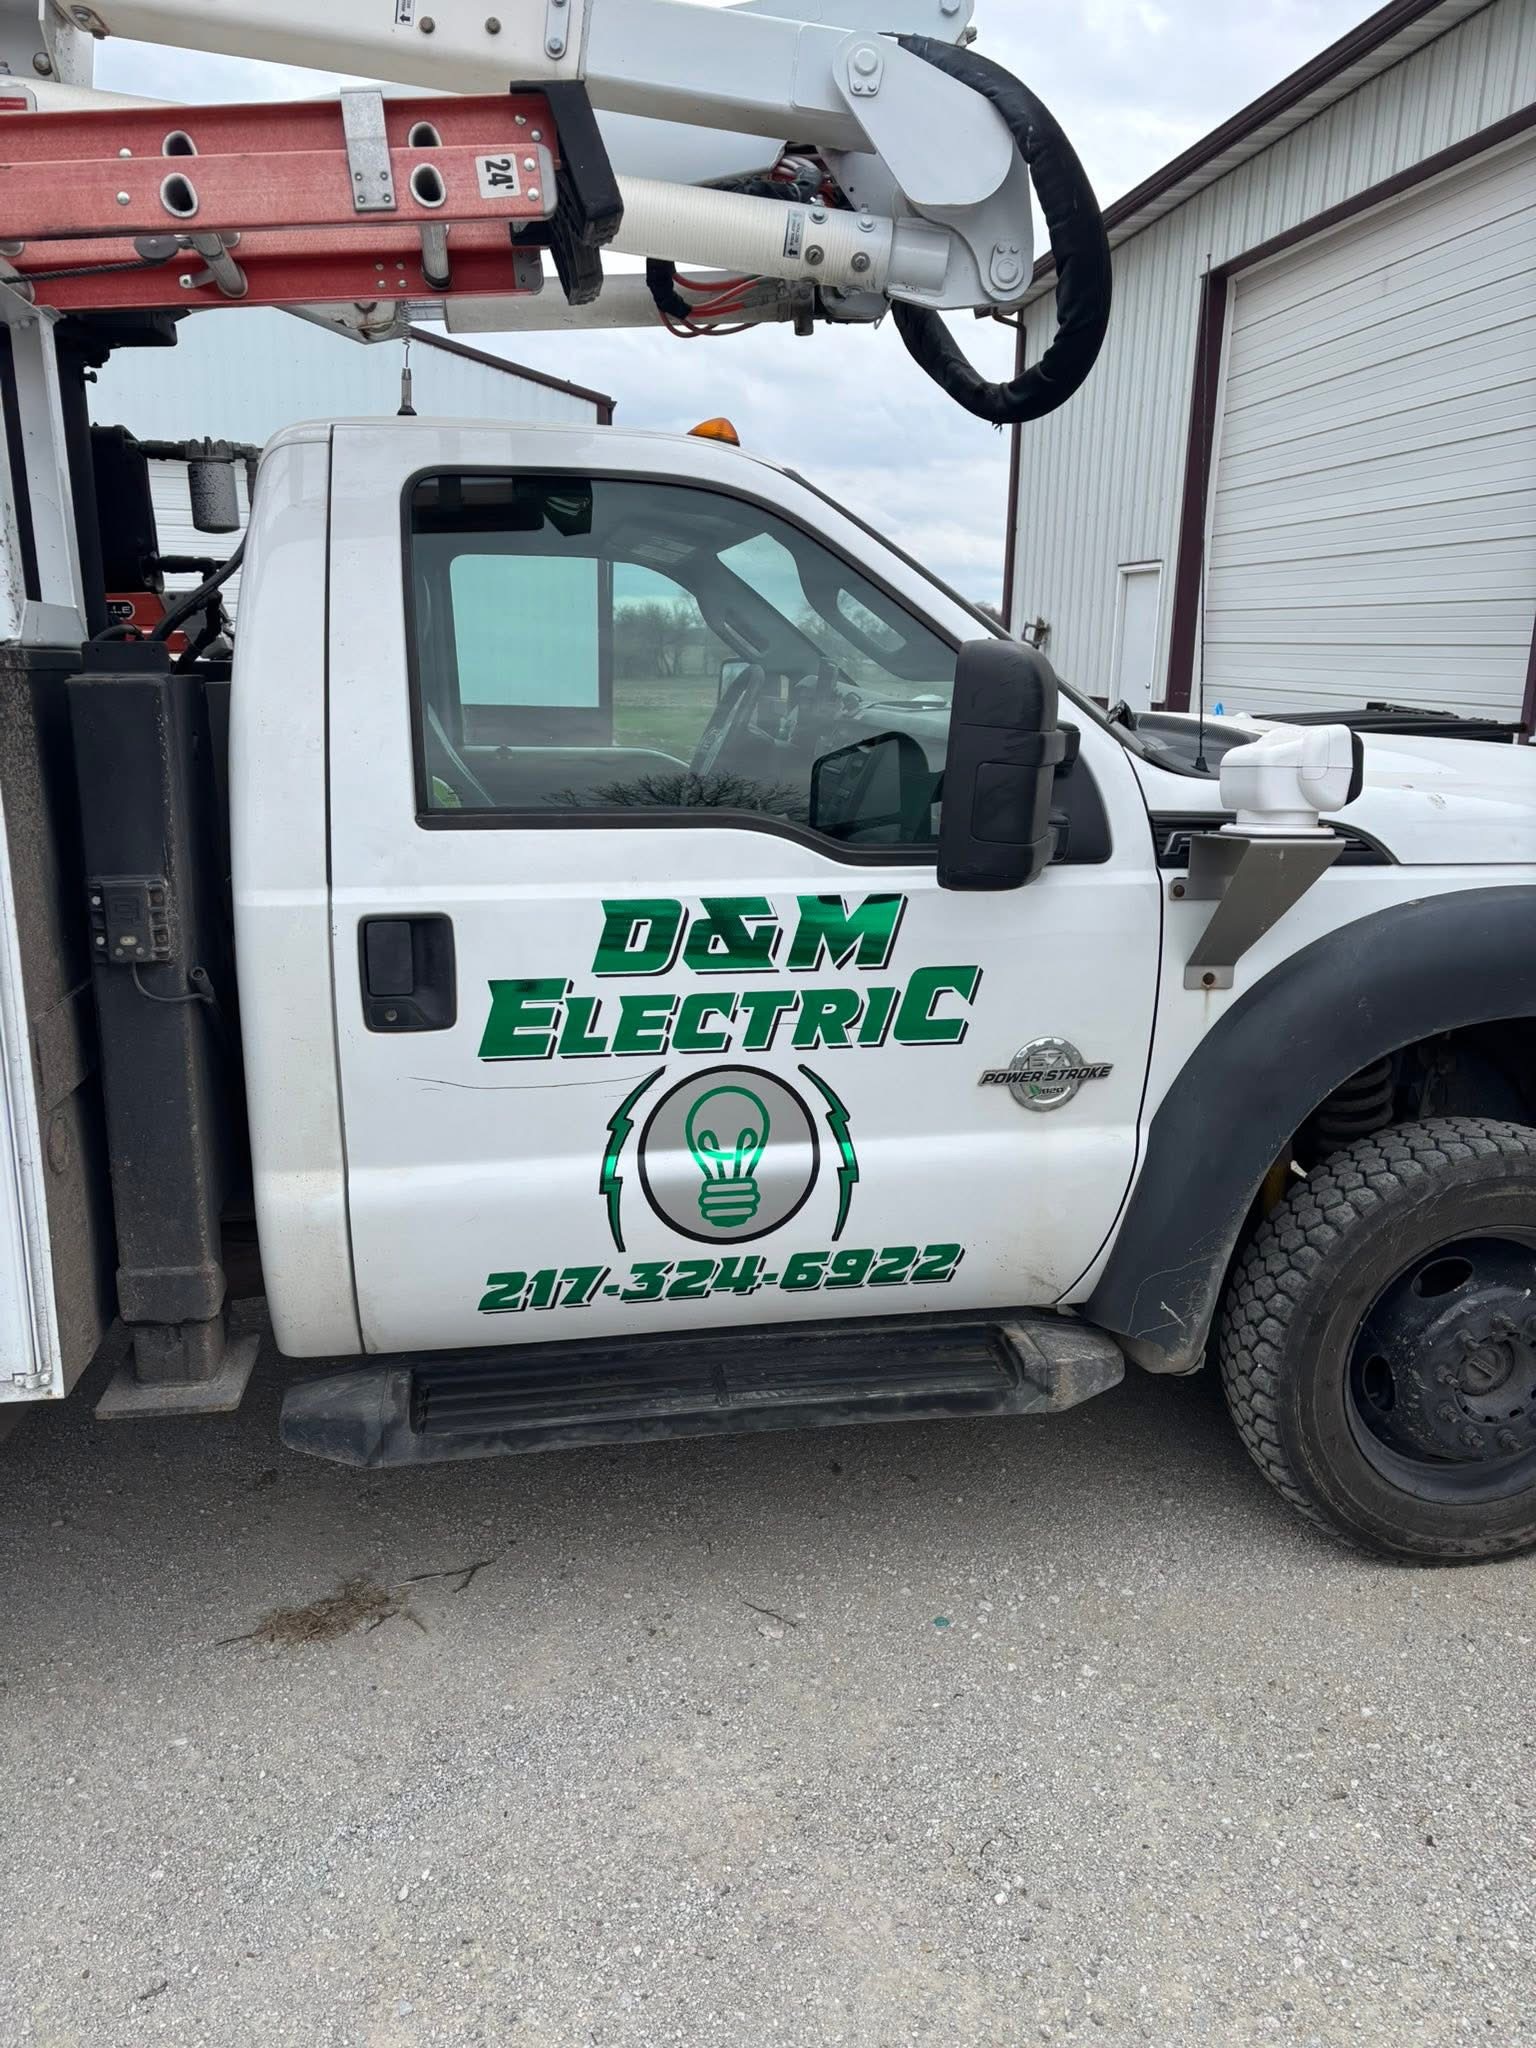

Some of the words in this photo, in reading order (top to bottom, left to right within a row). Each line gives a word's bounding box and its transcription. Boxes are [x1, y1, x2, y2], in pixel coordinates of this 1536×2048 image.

[485, 158, 514, 189] 24'
[591, 893, 909, 977] D&M
[477, 965, 984, 1062] ELECTRIC
[981, 1071, 1043, 1085] POWER
[1044, 1064, 1113, 1082] STROKE
[477, 1243, 965, 1314] 217-324-6922
